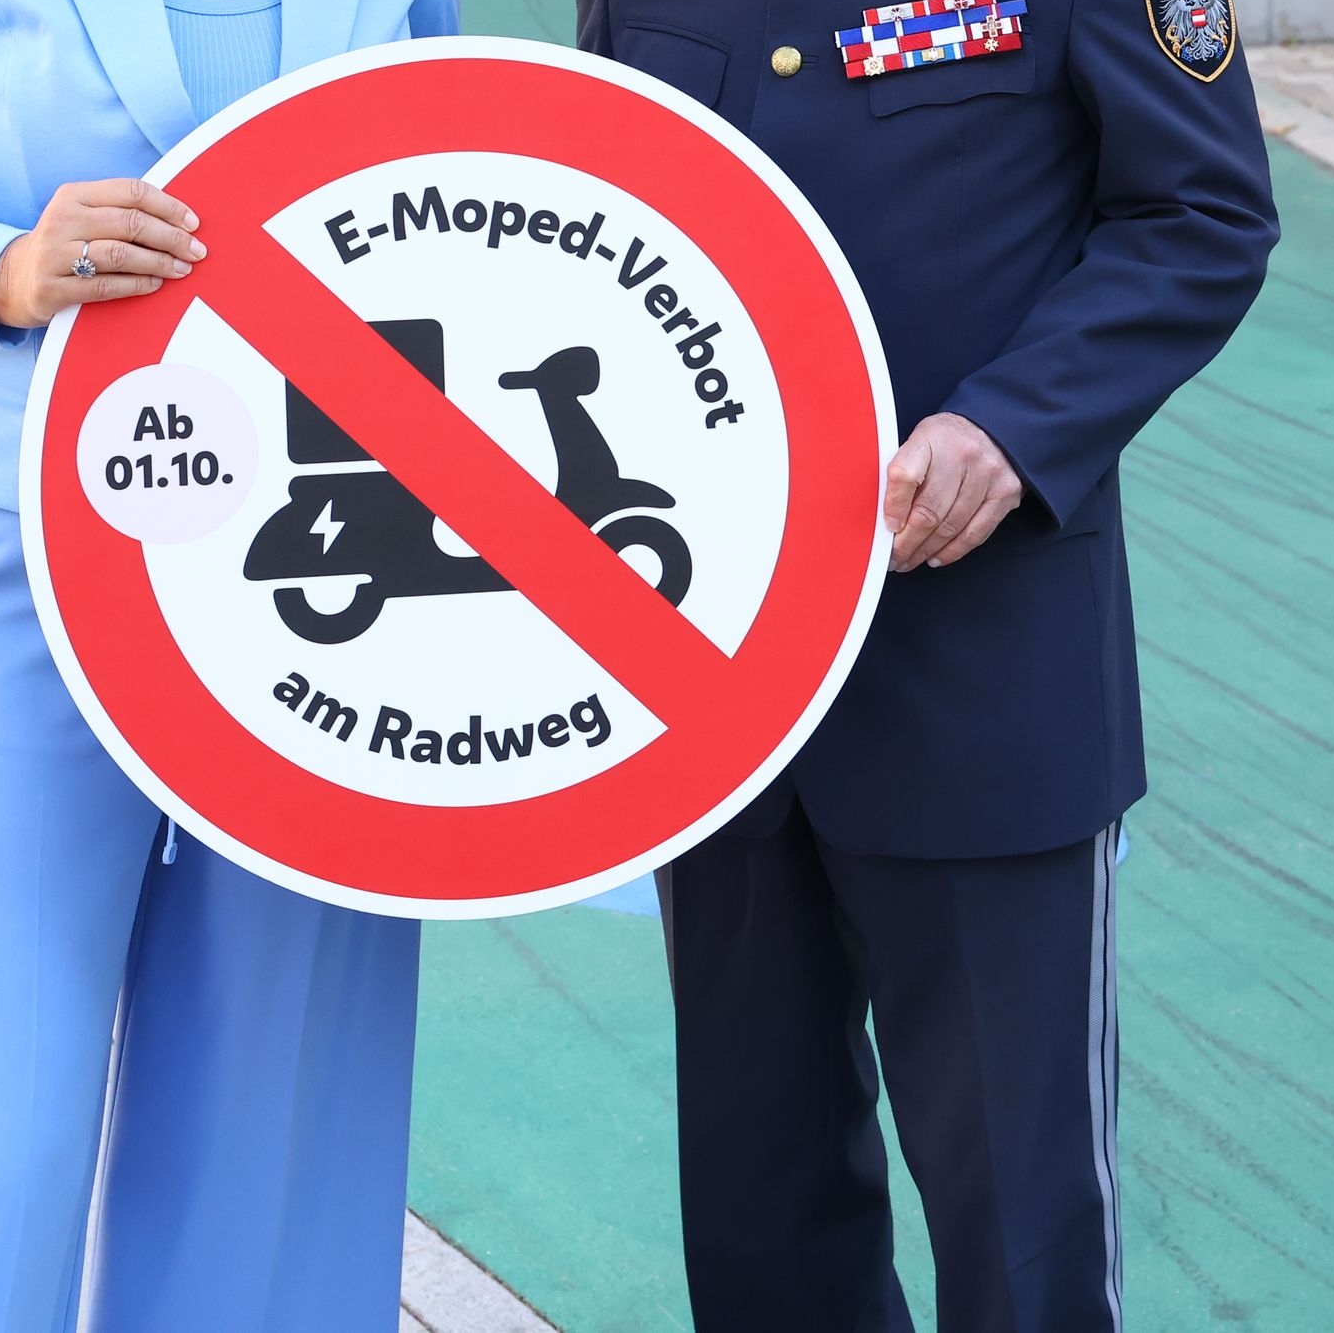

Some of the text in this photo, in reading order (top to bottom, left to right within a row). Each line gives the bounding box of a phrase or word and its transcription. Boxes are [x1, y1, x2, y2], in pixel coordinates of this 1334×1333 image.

[324, 186, 745, 429] E-Moped-Verbot
[133, 404, 194, 442] Ab
[105, 450, 233, 491] 01.10.
[273, 671, 612, 766] am Radweg
